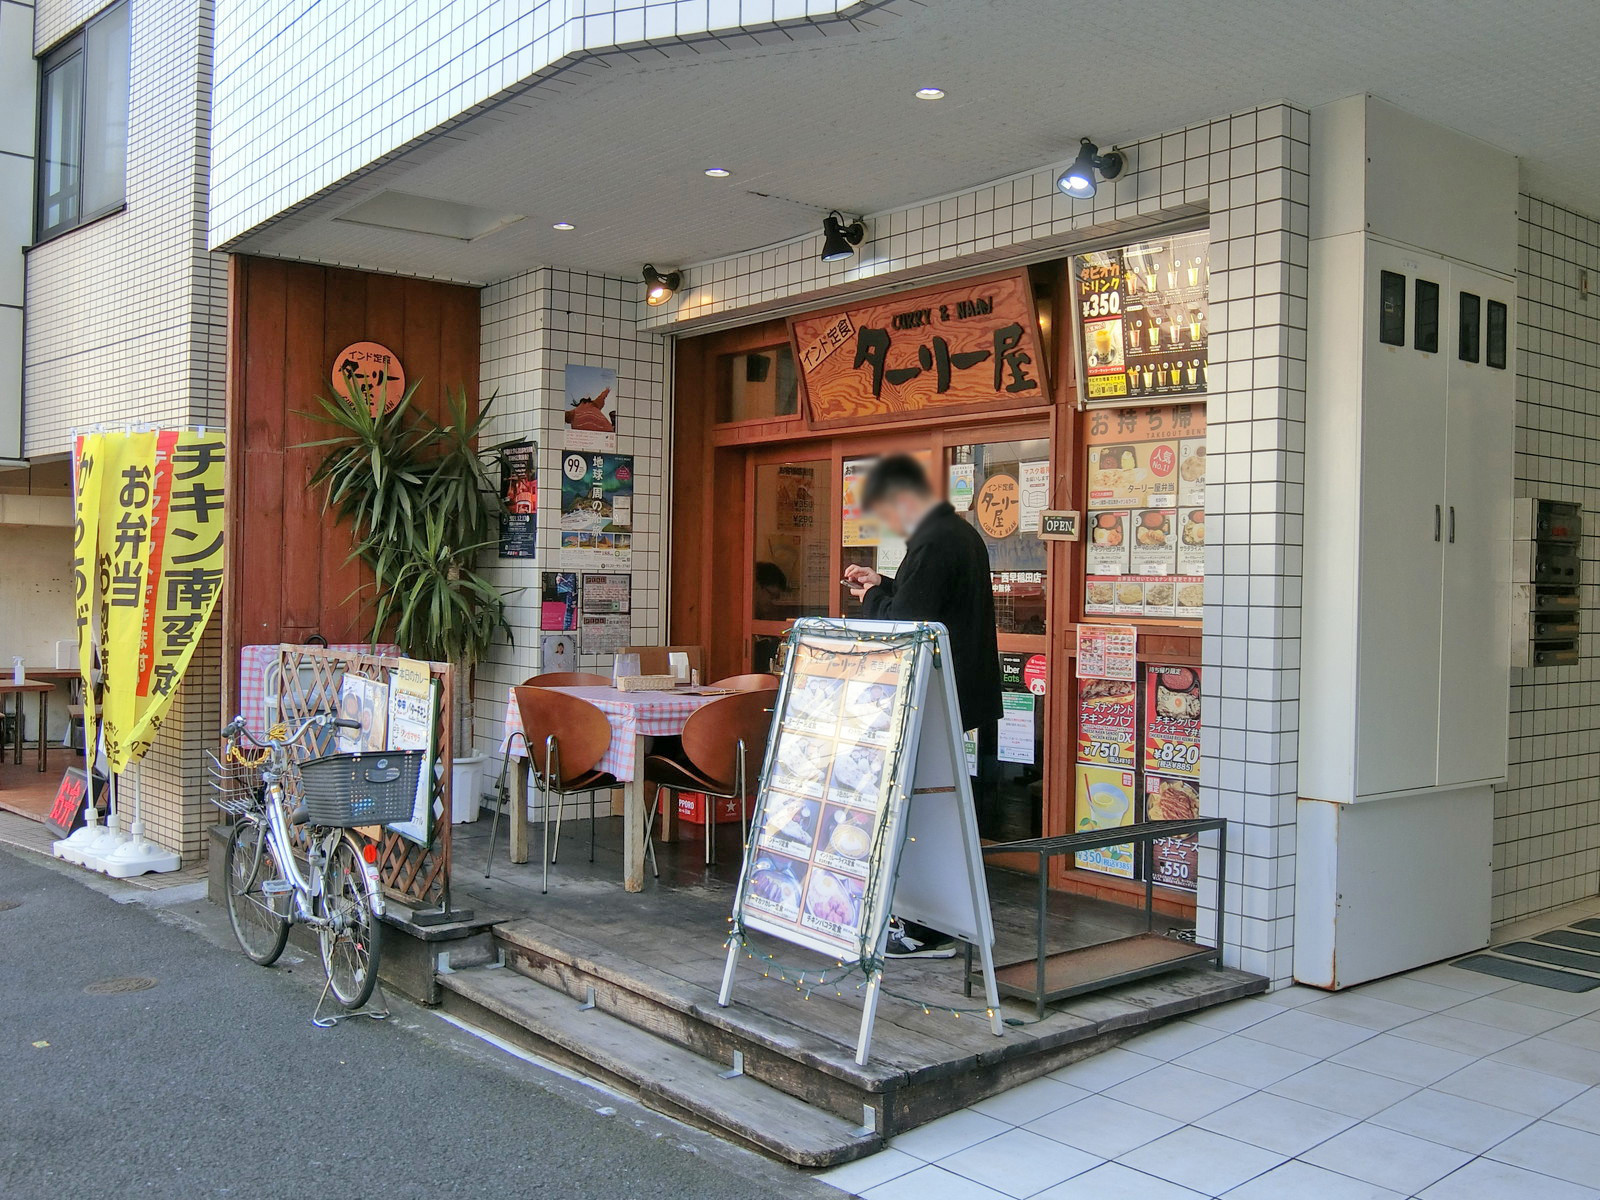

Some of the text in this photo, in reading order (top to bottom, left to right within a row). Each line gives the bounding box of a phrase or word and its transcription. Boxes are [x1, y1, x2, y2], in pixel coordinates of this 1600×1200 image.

[1081, 277, 1120, 295] ドリンク
[802, 318, 853, 368] インド定食
[853, 321, 1038, 400] ターリー屋
[1146, 431, 1181, 439] TAKEOUT
[567, 458, 580, 473] 99
[1128, 483, 1175, 493] ターリー屋弁当
[981, 491, 1019, 513] ターリー
[992, 509, 1004, 528] 屋
[1046, 520, 1073, 532] OPEN
[112, 465, 152, 608] お弁当
[1003, 665, 1020, 674] Uber
[1003, 674, 1020, 683] Eats
[1081, 700, 1133, 715] チーズナンサンド
[1117, 732, 1132, 743] DX
[1083, 741, 1120, 758] ¥750
[1153, 742, 1200, 764] ¥820
[1162, 847, 1187, 860] キーマ
[1160, 861, 1189, 879] ¥550
